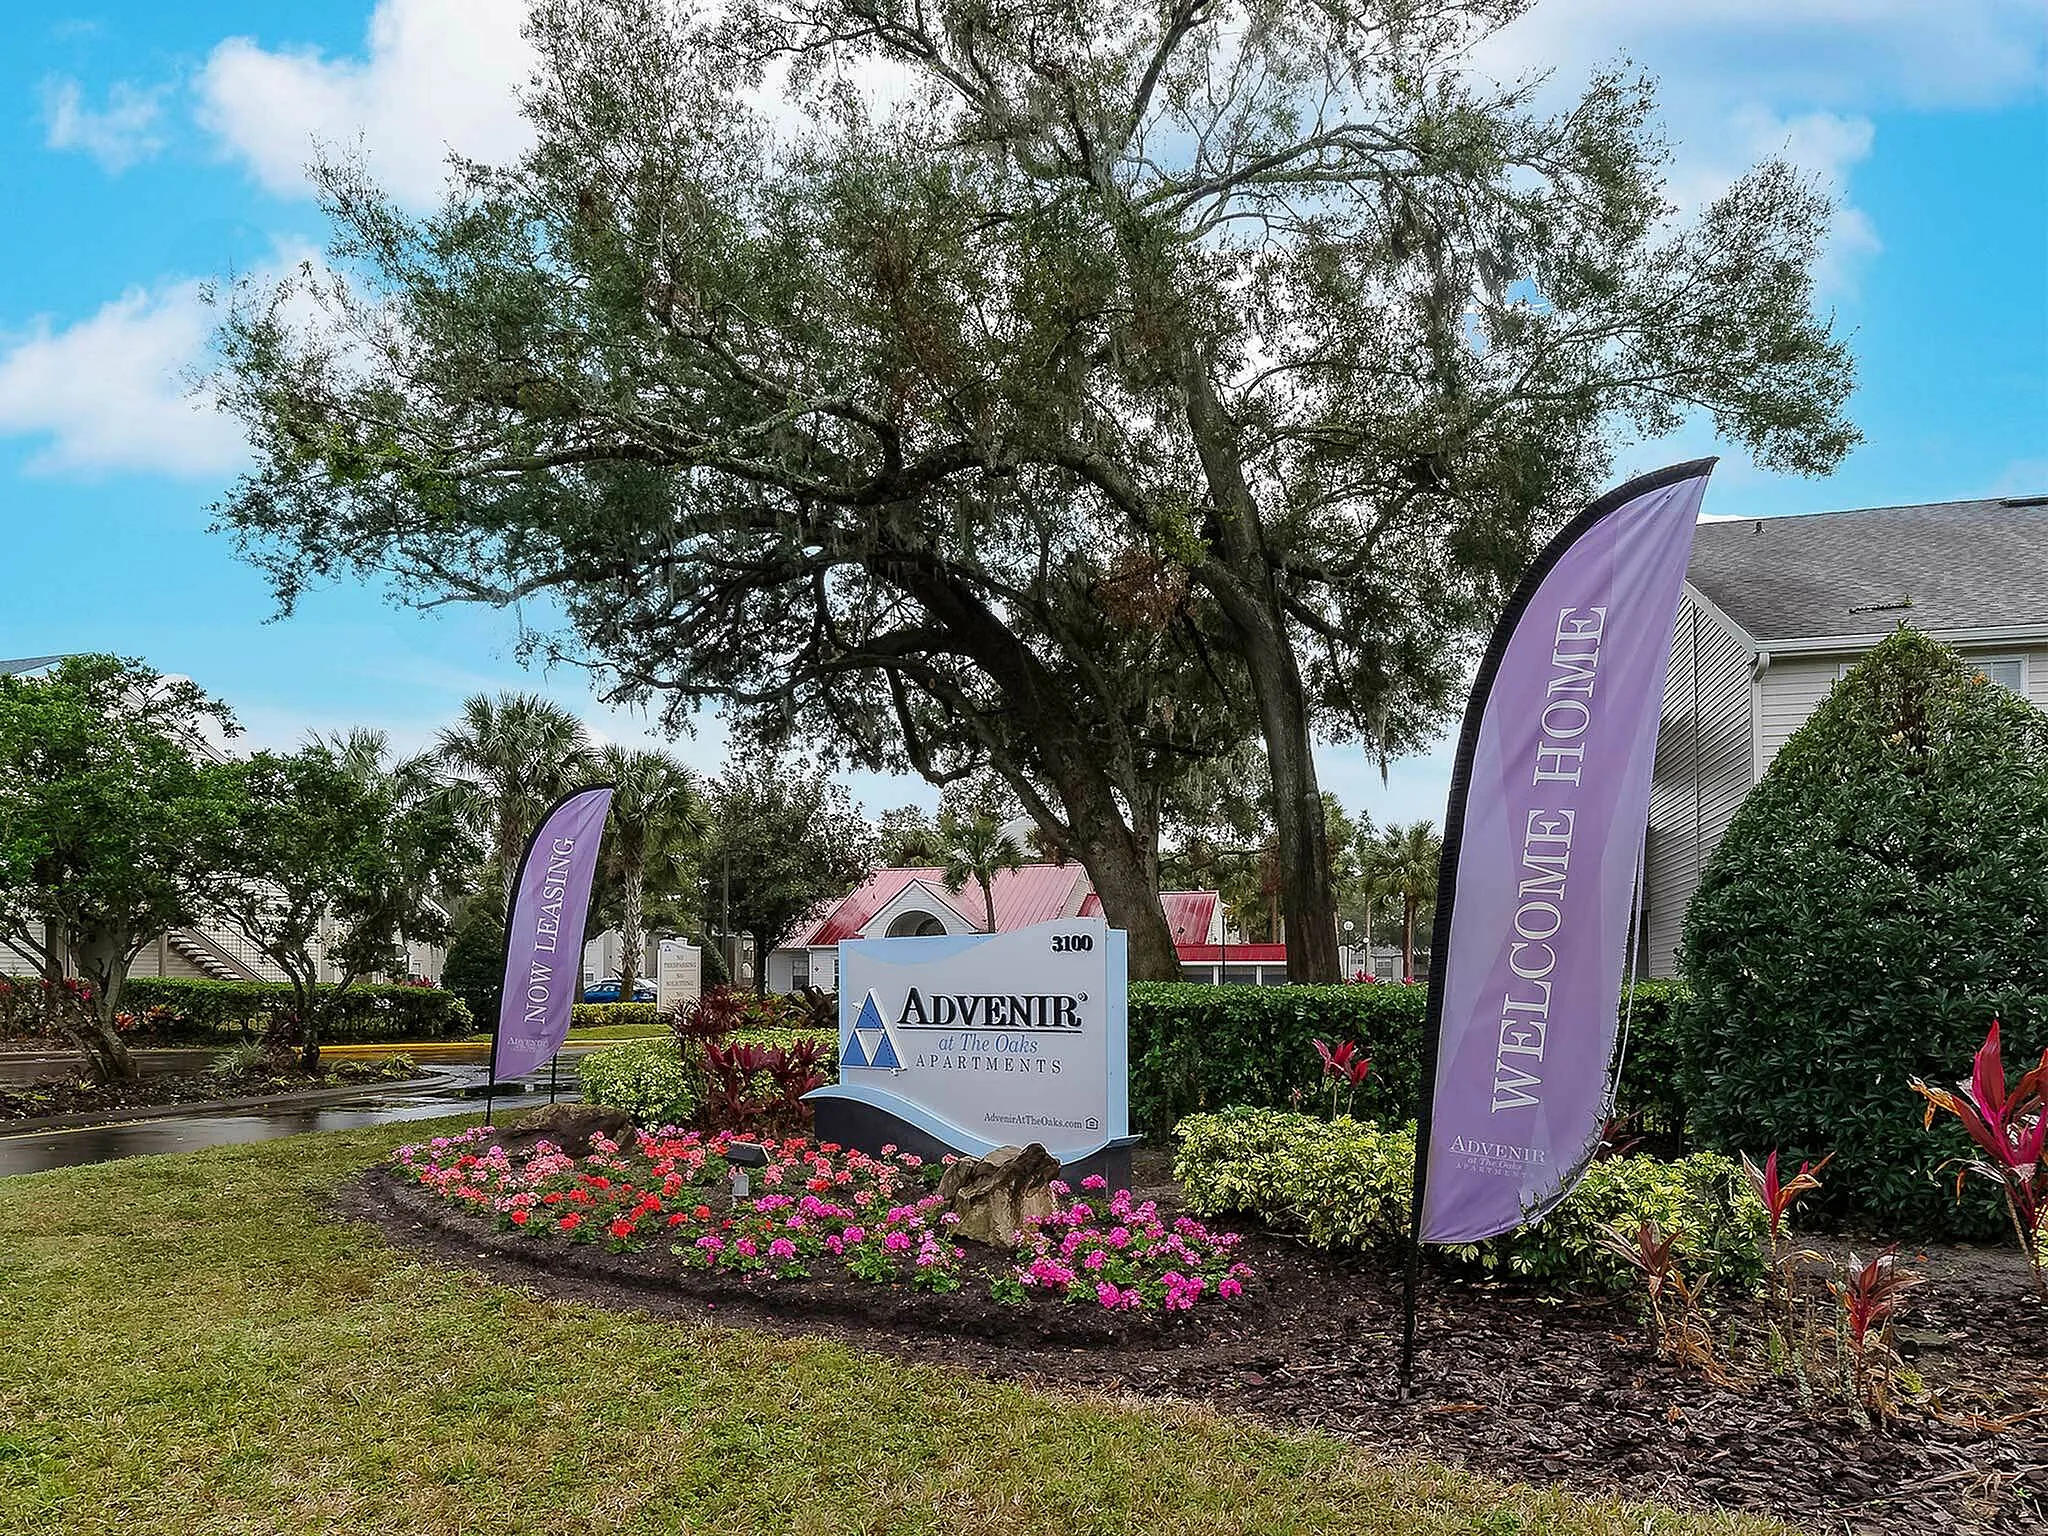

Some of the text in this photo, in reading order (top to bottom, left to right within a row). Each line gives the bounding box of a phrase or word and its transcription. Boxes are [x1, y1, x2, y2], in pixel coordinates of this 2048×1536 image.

[1491, 605, 1608, 1113] WELCOME HOME
[524, 837, 576, 1025] NOW LEASING
[1051, 934, 1093, 952] 3100
[897, 987, 1082, 1028] ADVENIR
[938, 1033, 1038, 1054] at The Oaks
[916, 1054, 1062, 1074] APARTMENTS
[984, 1112, 1082, 1129] AdvenirAtTheOaks.com
[1449, 1135, 1545, 1162] ADVENIR
